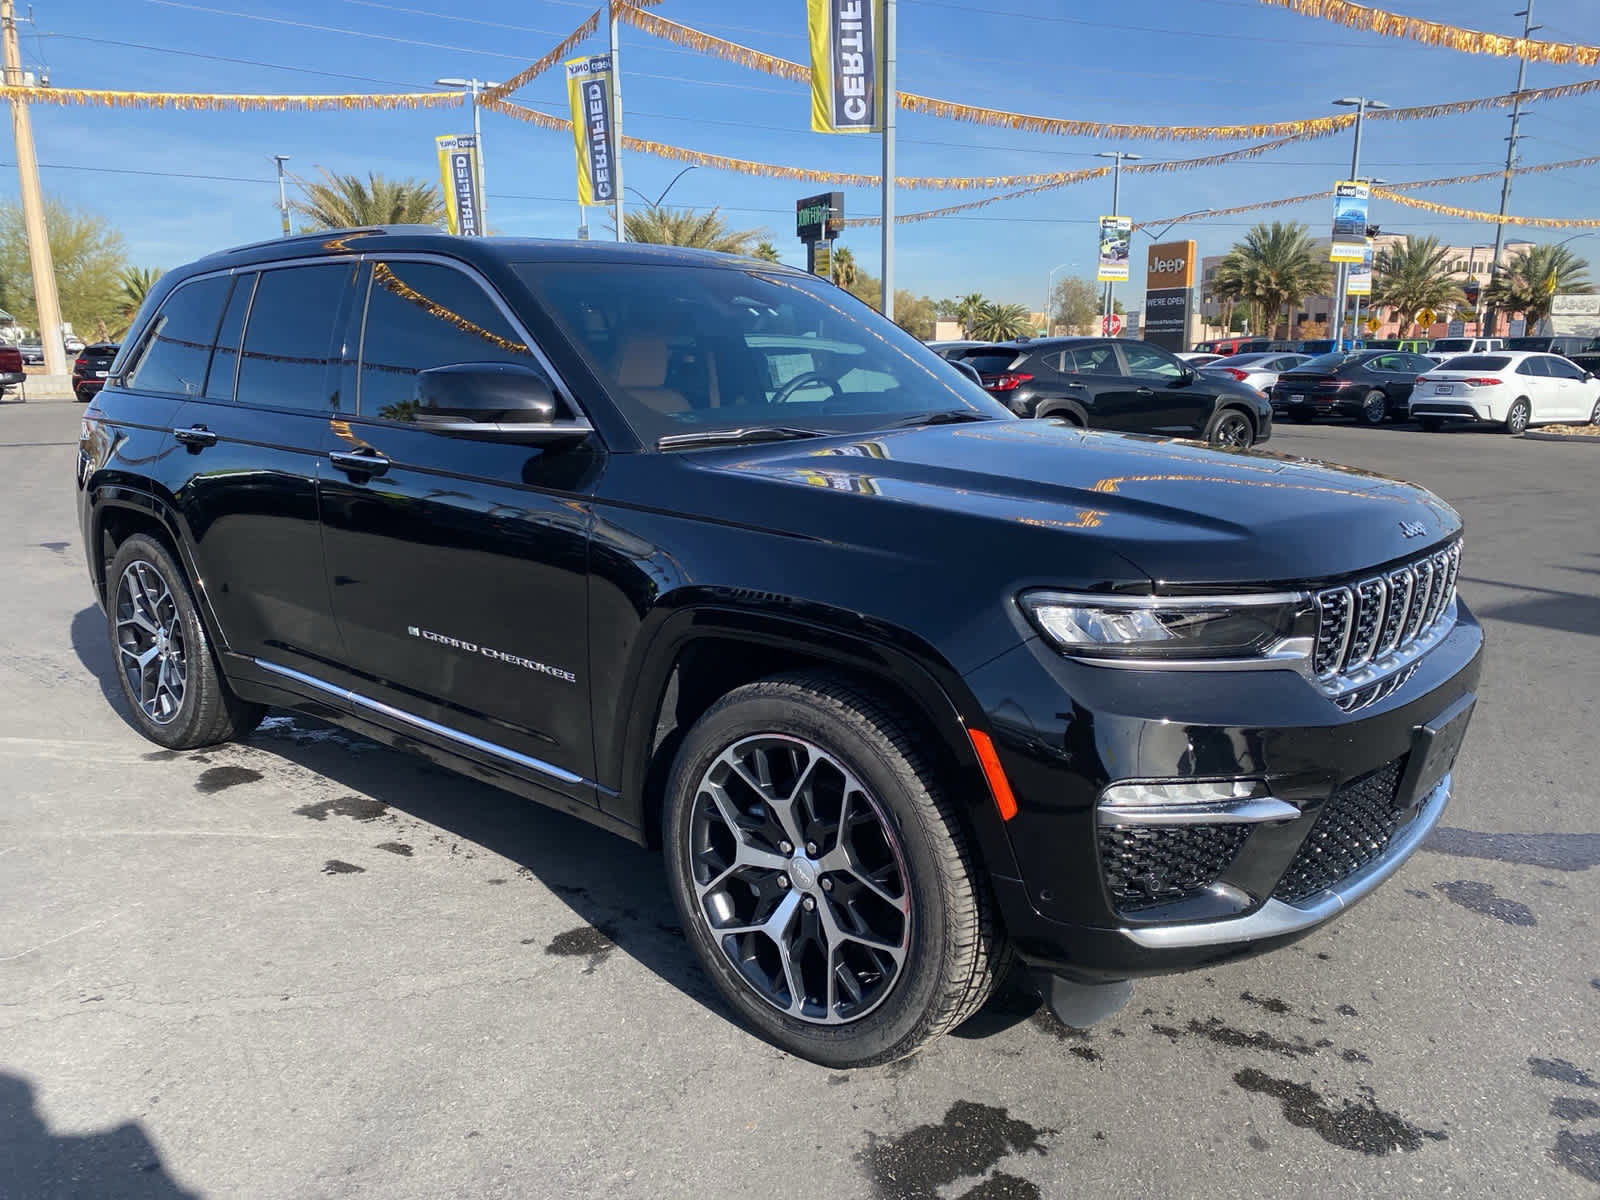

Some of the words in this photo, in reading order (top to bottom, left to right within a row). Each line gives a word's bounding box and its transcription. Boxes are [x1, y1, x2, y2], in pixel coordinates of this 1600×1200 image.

[1150, 257, 1185, 274] Jeep
[1167, 296, 1184, 305] OPEN
[422, 630, 477, 652] GRAND
[481, 647, 576, 682] CHEROKEE
